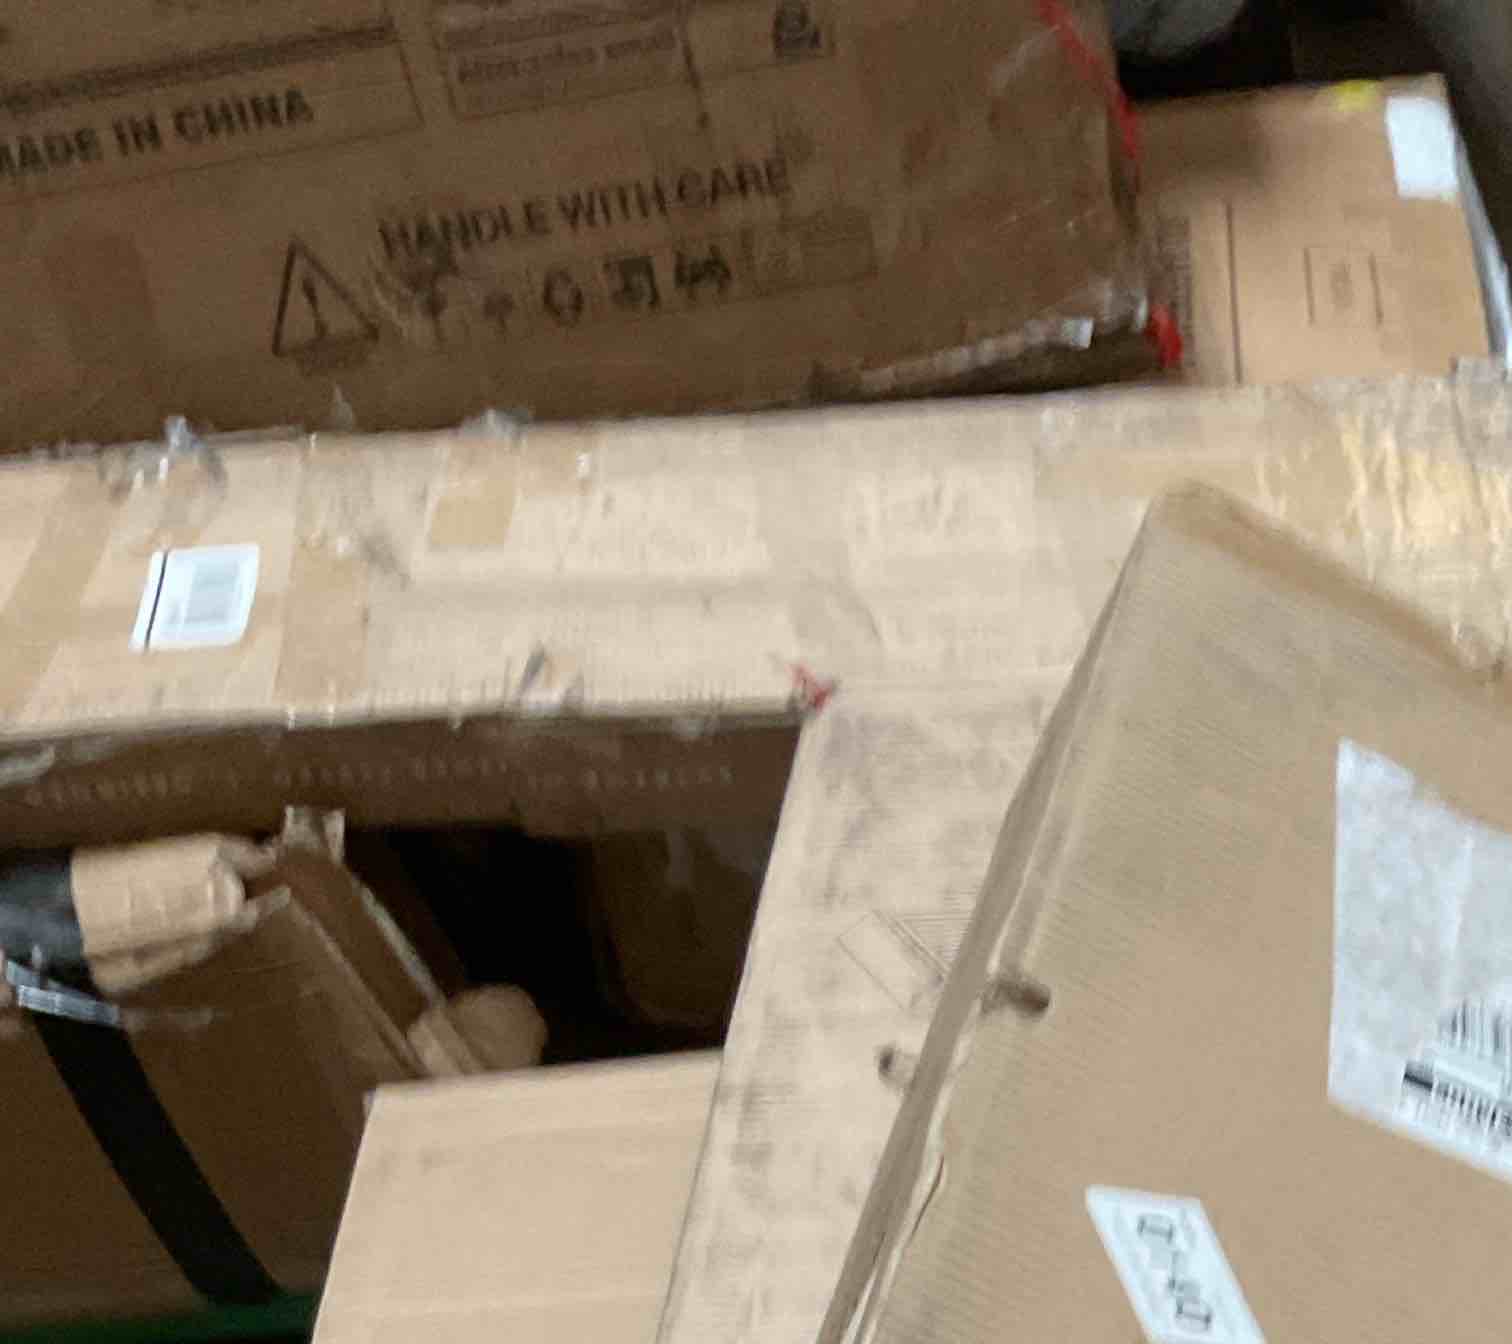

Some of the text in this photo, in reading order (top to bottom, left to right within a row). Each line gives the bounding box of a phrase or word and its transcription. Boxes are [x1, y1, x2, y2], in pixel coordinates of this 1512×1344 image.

[112, 112, 163, 156] IN
[173, 89, 315, 148] CHINA
[378, 196, 549, 260] HANDLE
[558, 174, 667, 232] WITH
